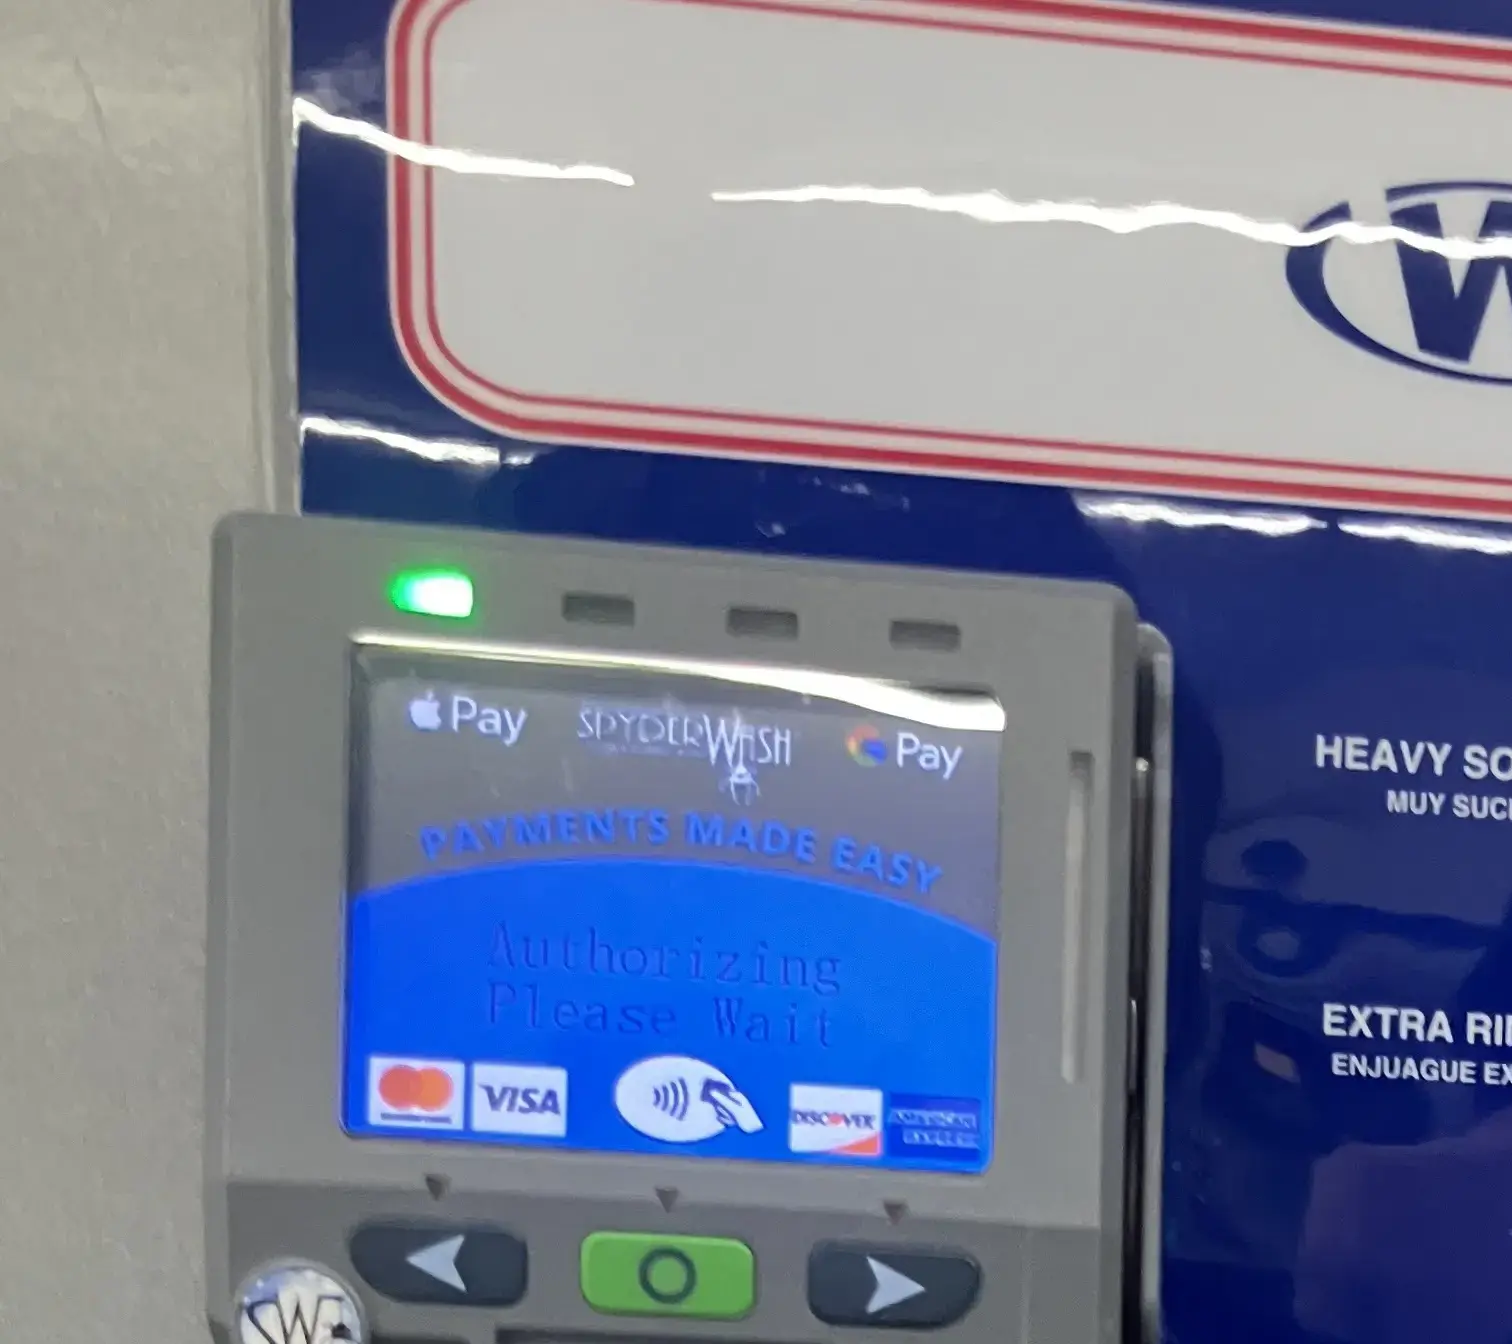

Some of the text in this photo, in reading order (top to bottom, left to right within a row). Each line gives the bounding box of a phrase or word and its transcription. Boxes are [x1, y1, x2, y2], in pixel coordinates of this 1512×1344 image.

[451, 697, 527, 747] Pay
[897, 732, 963, 780] Pay
[1314, 734, 1451, 776] HEAVY
[1387, 790, 1445, 817] MUY
[420, 808, 943, 895] PAYMENTS MADE EASY
[488, 921, 842, 996] Authorizing
[488, 981, 834, 1048] Please Wait
[1322, 1003, 1453, 1043] EXTRA
[1331, 1052, 1476, 1085] ENJUAGUE
[479, 1083, 561, 1115] VISA
